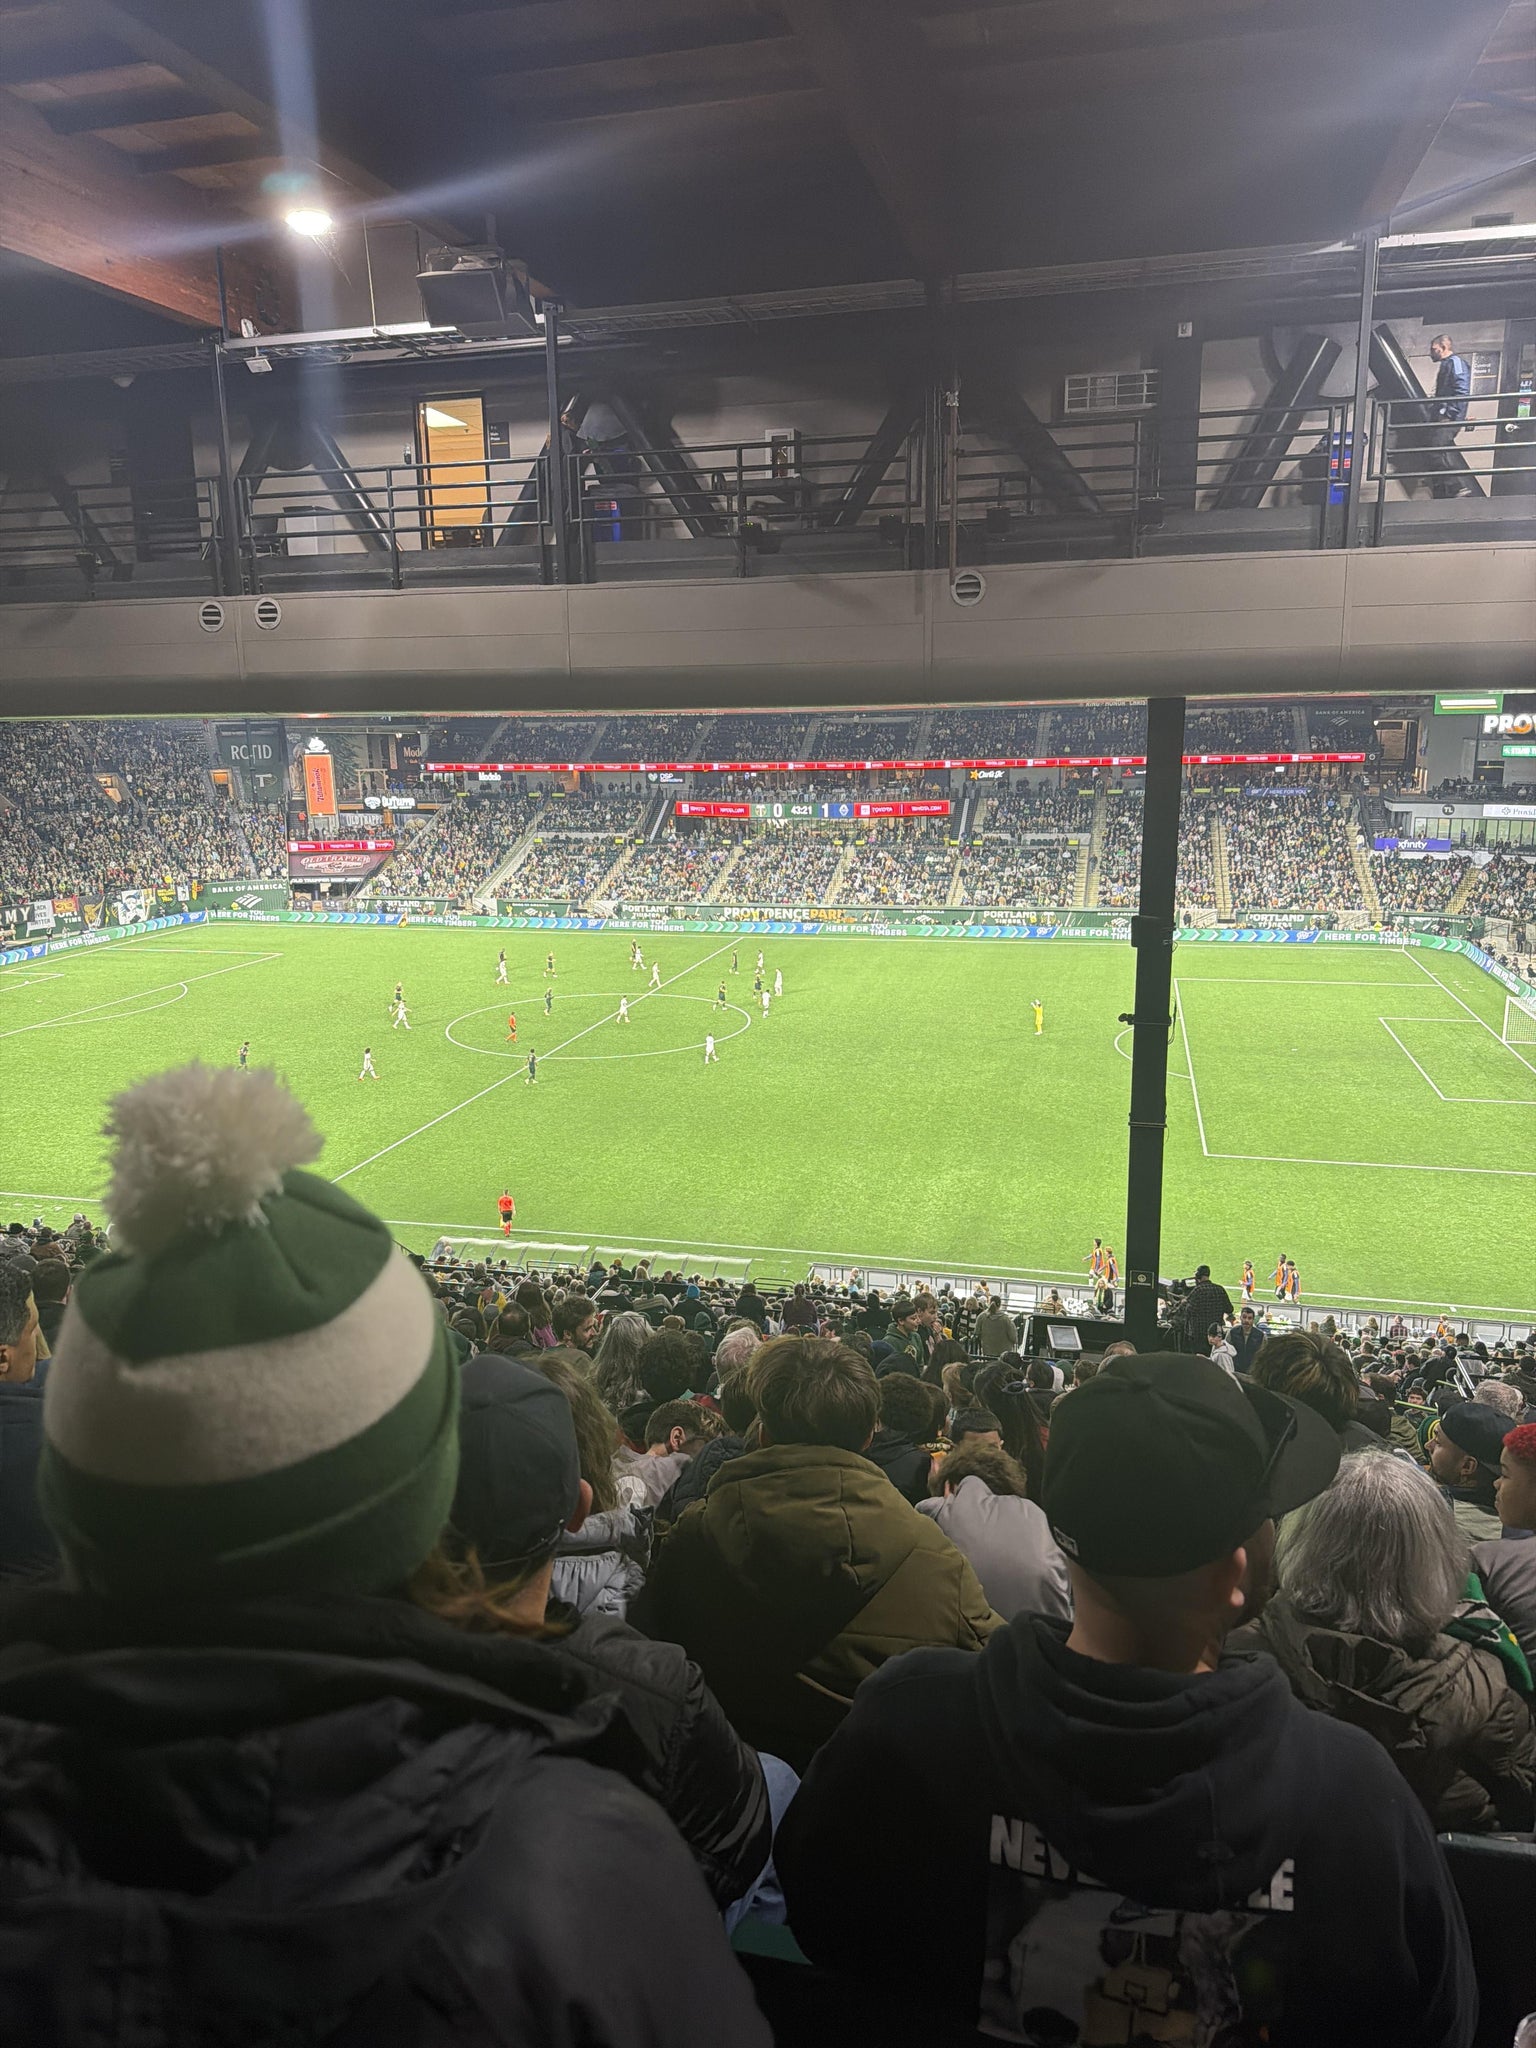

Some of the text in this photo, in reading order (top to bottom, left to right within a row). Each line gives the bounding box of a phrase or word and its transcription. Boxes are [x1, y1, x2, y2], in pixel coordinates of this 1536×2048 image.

[773, 803, 783, 818] 0
[821, 803, 829, 818] 1
[247, 883, 284, 892] AMERICA
[1324, 933, 1376, 941] HERE FOR
[1379, 938, 1421, 947] TIMBERS
